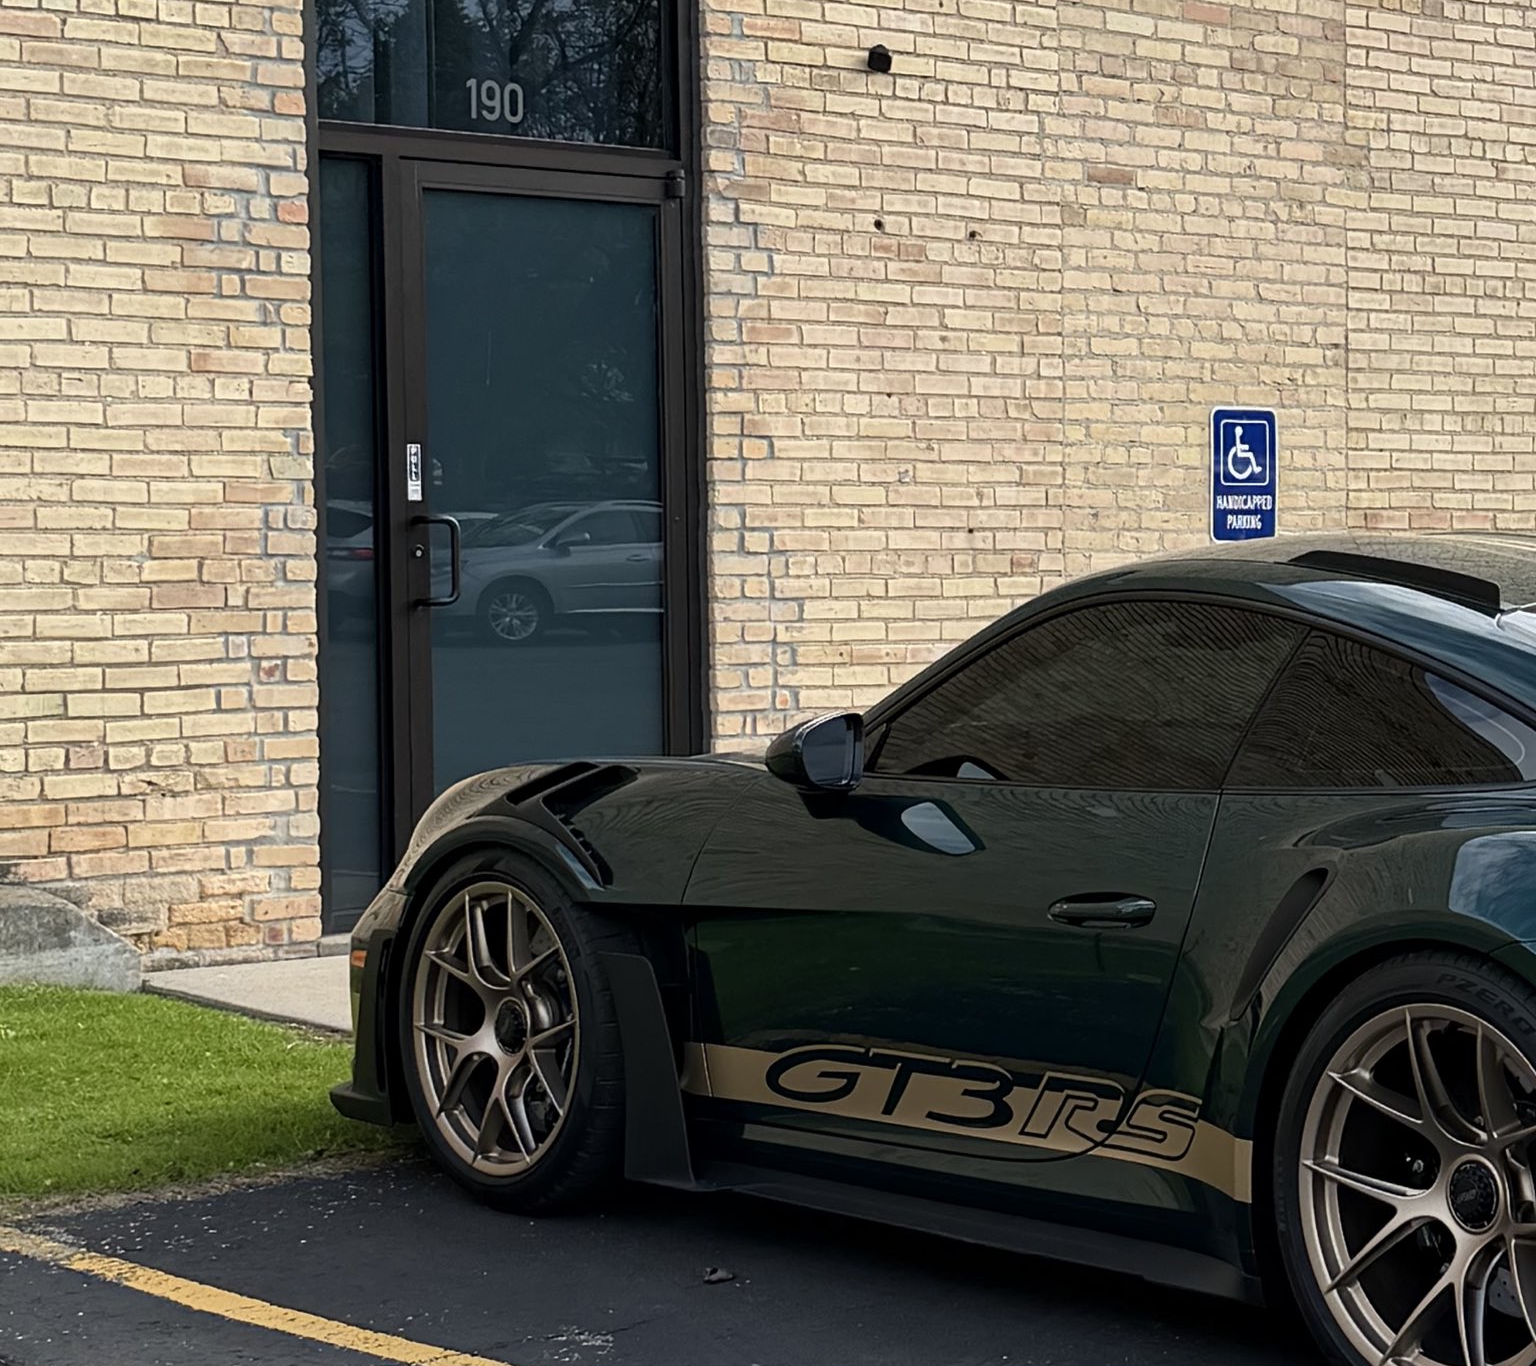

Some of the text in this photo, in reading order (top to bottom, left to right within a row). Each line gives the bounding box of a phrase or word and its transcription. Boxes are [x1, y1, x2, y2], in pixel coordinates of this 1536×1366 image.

[466, 78, 524, 124] 190
[1216, 495, 1273, 510] HANDICAPPED
[1227, 514, 1262, 529] PARKING
